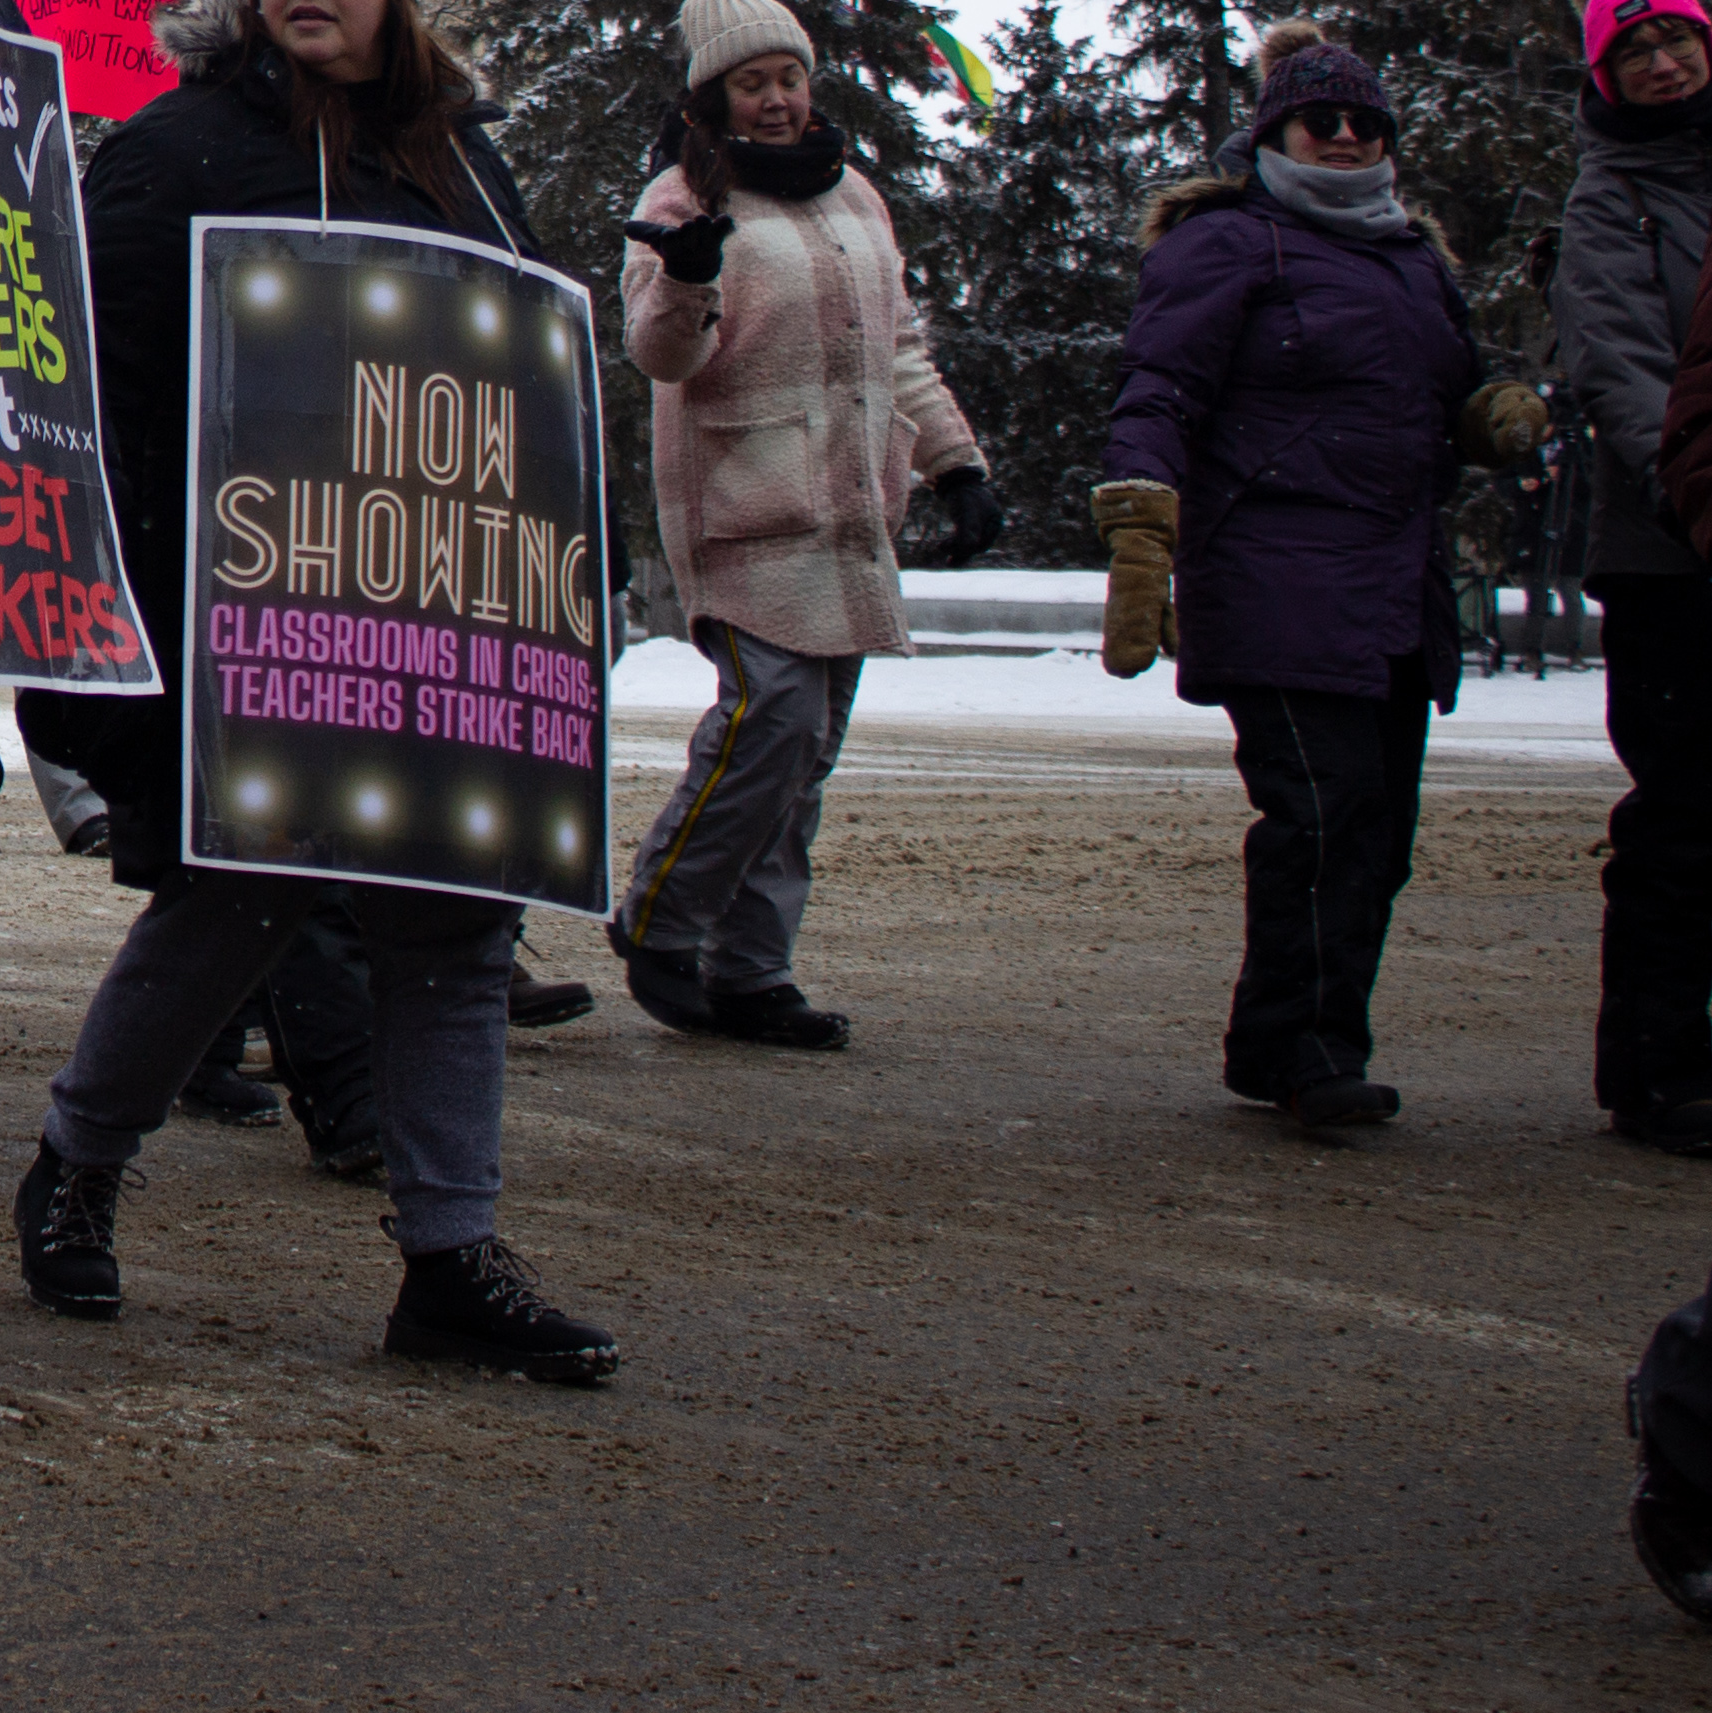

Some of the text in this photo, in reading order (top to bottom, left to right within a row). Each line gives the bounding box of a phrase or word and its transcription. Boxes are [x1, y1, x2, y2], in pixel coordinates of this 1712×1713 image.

[352, 360, 515, 500] NOW
[212, 475, 593, 649] SHOWING
[209, 604, 598, 713] CLASSROOMS IN CRISIS:
[218, 664, 594, 770] TEACHERS STRIKE BACK
